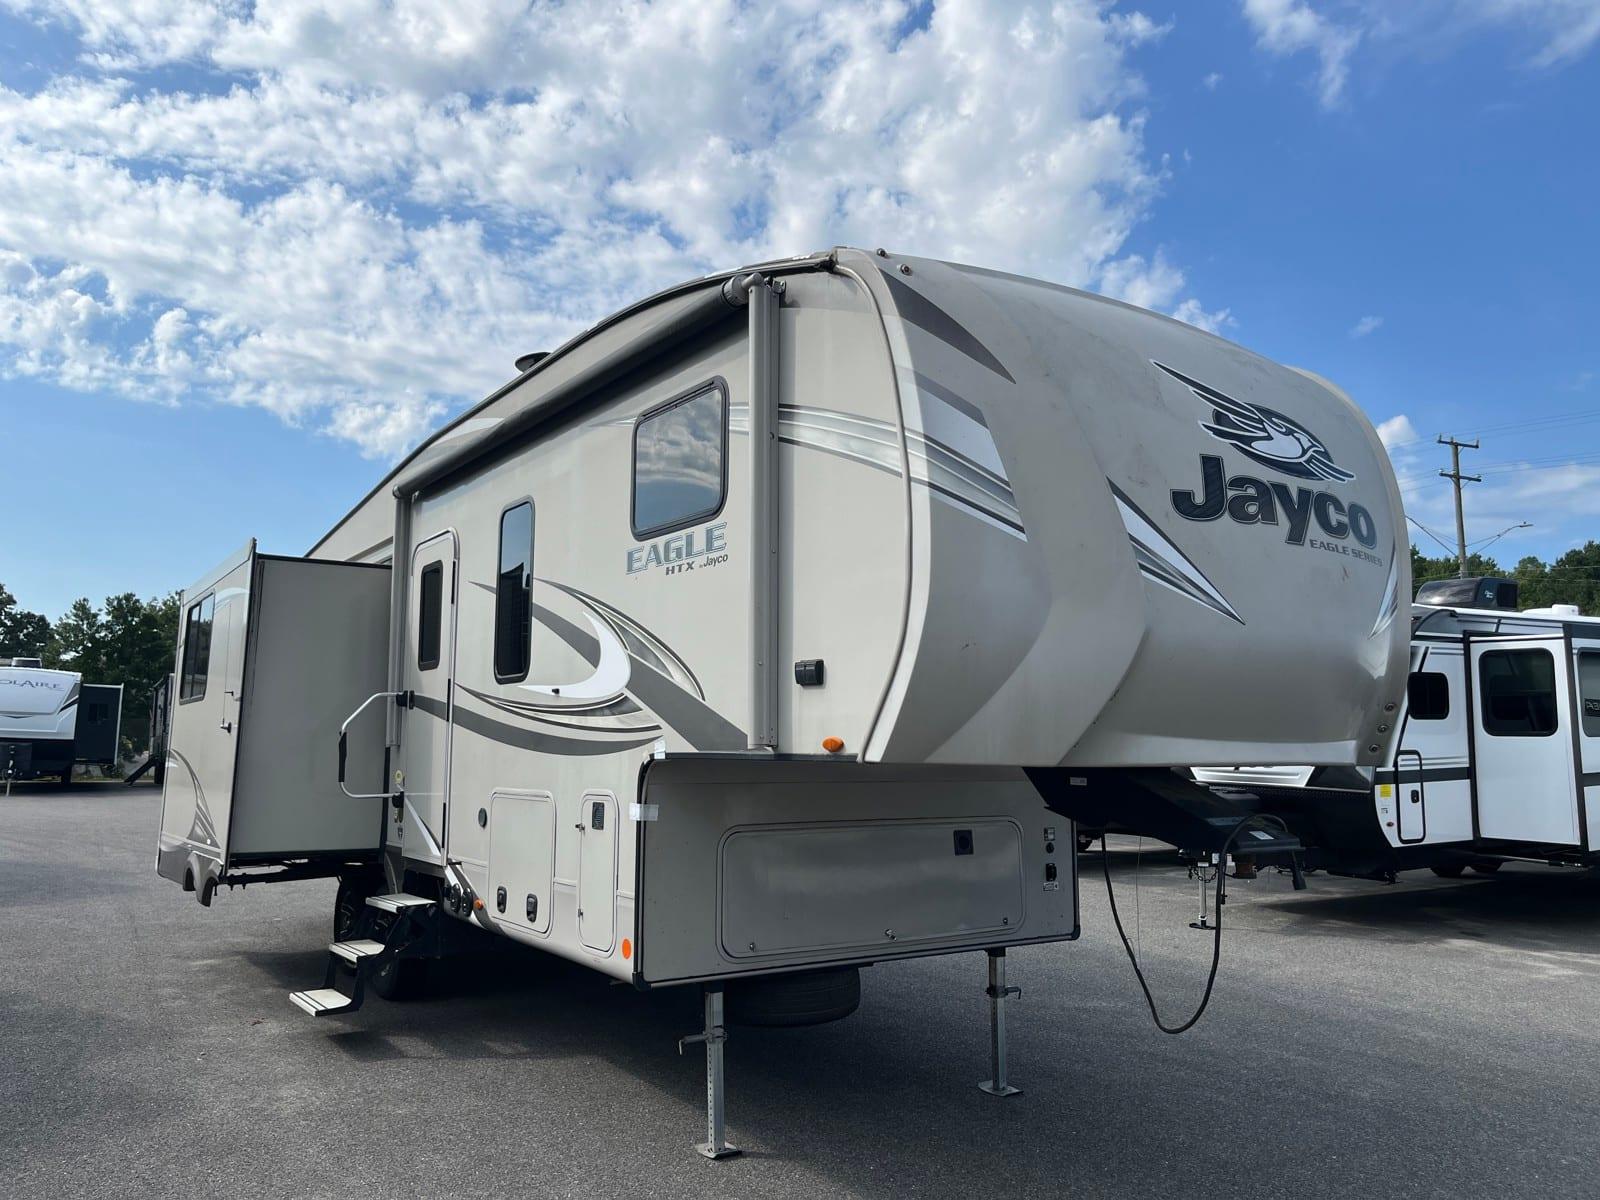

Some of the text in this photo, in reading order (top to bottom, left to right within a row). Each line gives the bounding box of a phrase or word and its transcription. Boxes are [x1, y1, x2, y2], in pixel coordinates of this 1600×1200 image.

[1170, 453, 1378, 550] Jayco
[625, 521, 728, 576] EAGLE
[665, 561, 696, 576] HTX
[703, 554, 729, 568] Jayco
[1309, 539, 1383, 567] EAGLE SERIES
